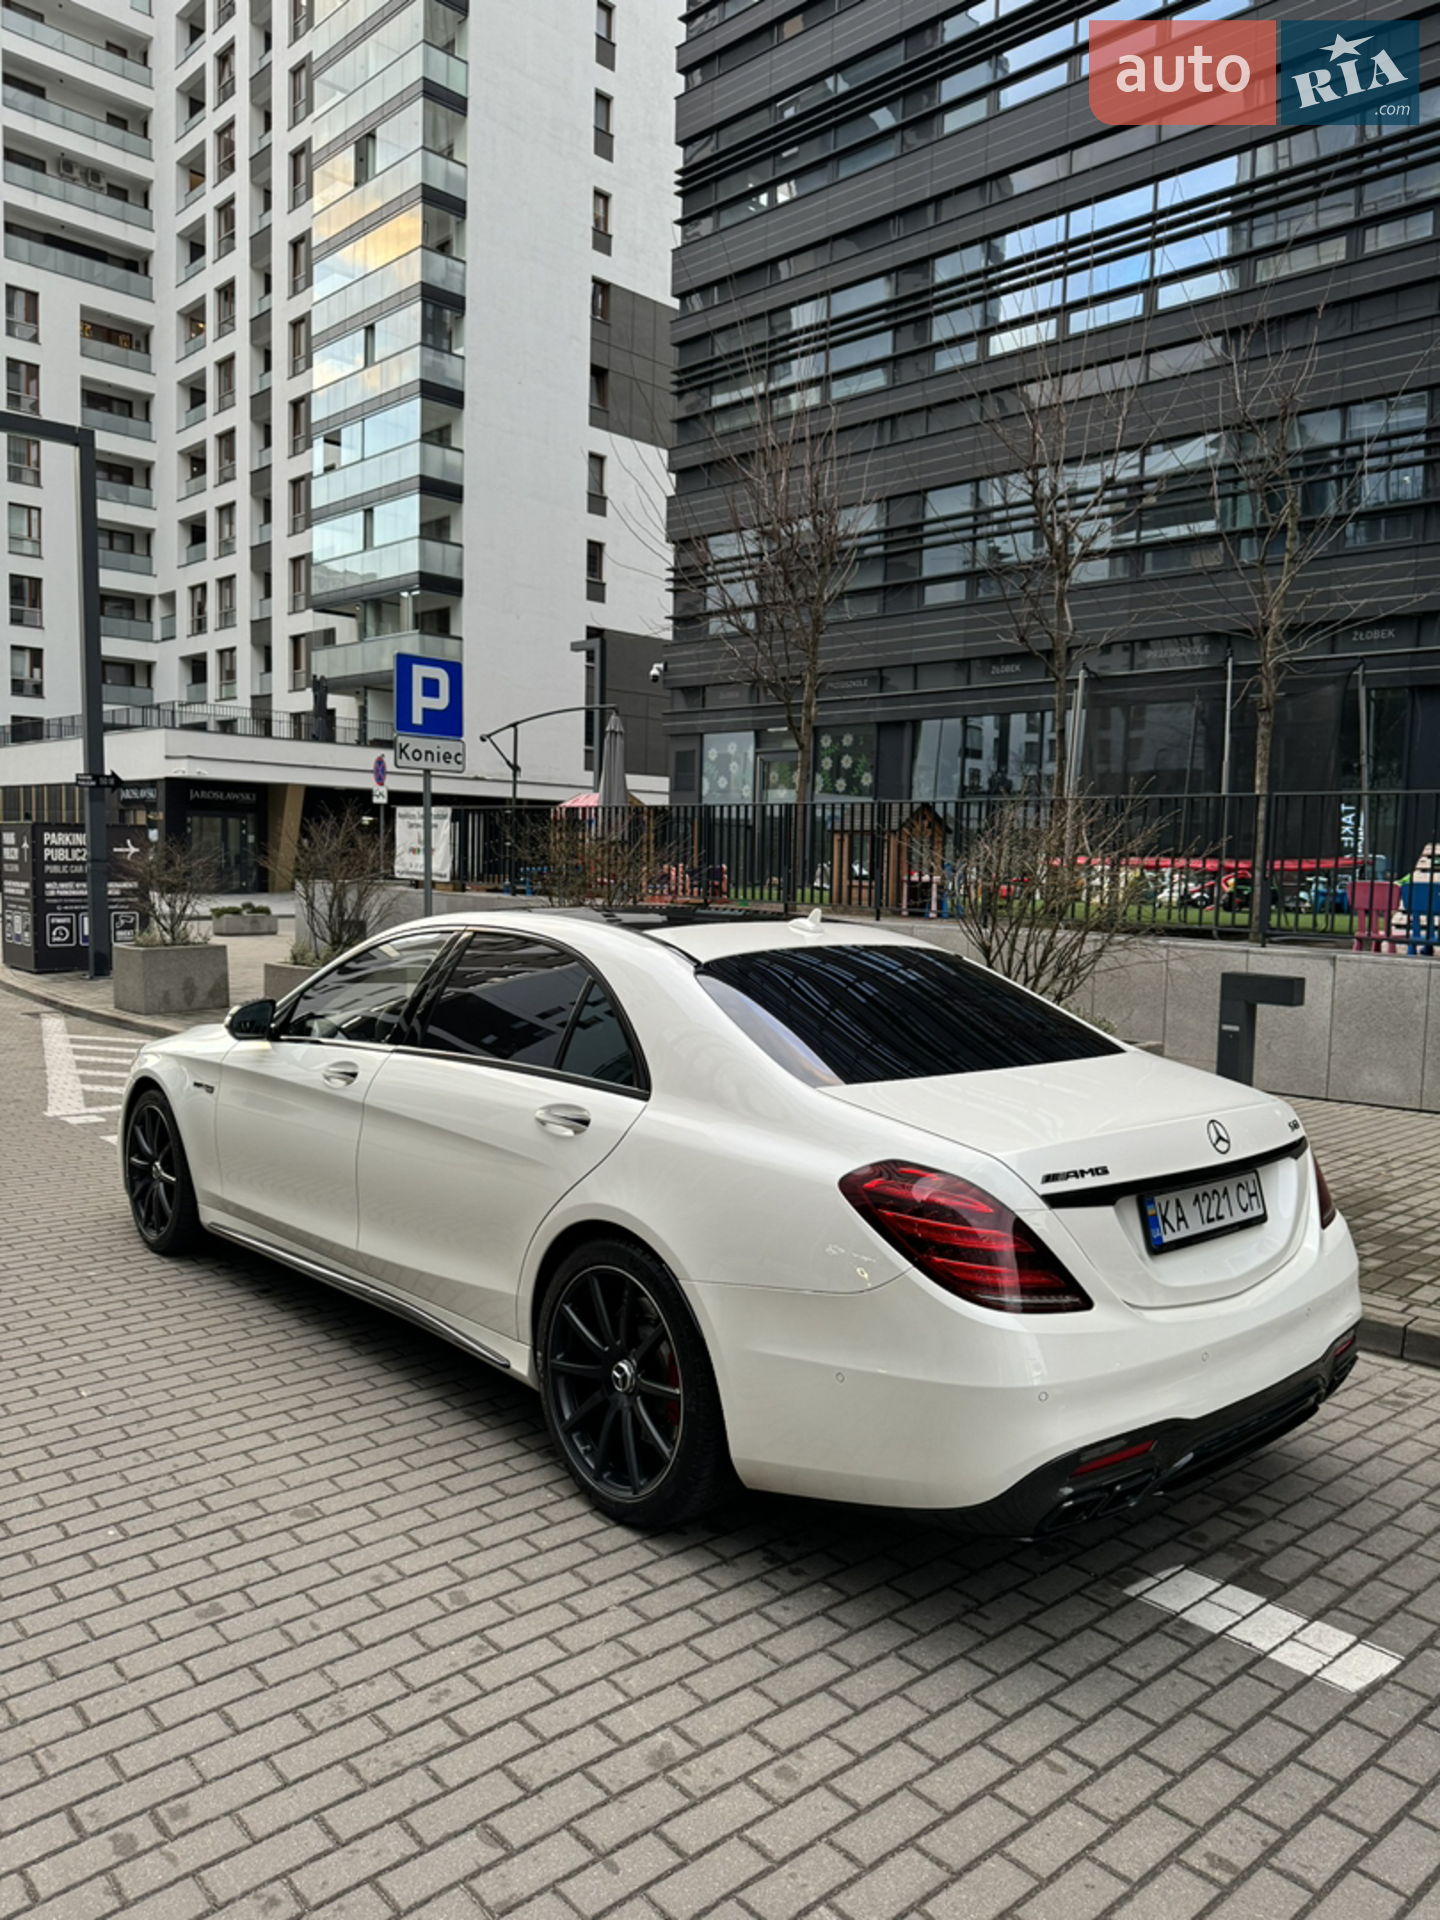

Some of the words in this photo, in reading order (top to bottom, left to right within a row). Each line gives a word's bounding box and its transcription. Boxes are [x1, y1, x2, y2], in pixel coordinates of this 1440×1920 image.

[412, 664, 450, 726] P
[398, 742, 463, 766] Koniec
[189, 788, 256, 802] JAROSŁAWSKI
[1062, 1166, 1110, 1181] AMG
[1158, 1197, 1190, 1235] KA
[1193, 1186, 1234, 1225] 1221
[1236, 1179, 1260, 1213] CH
